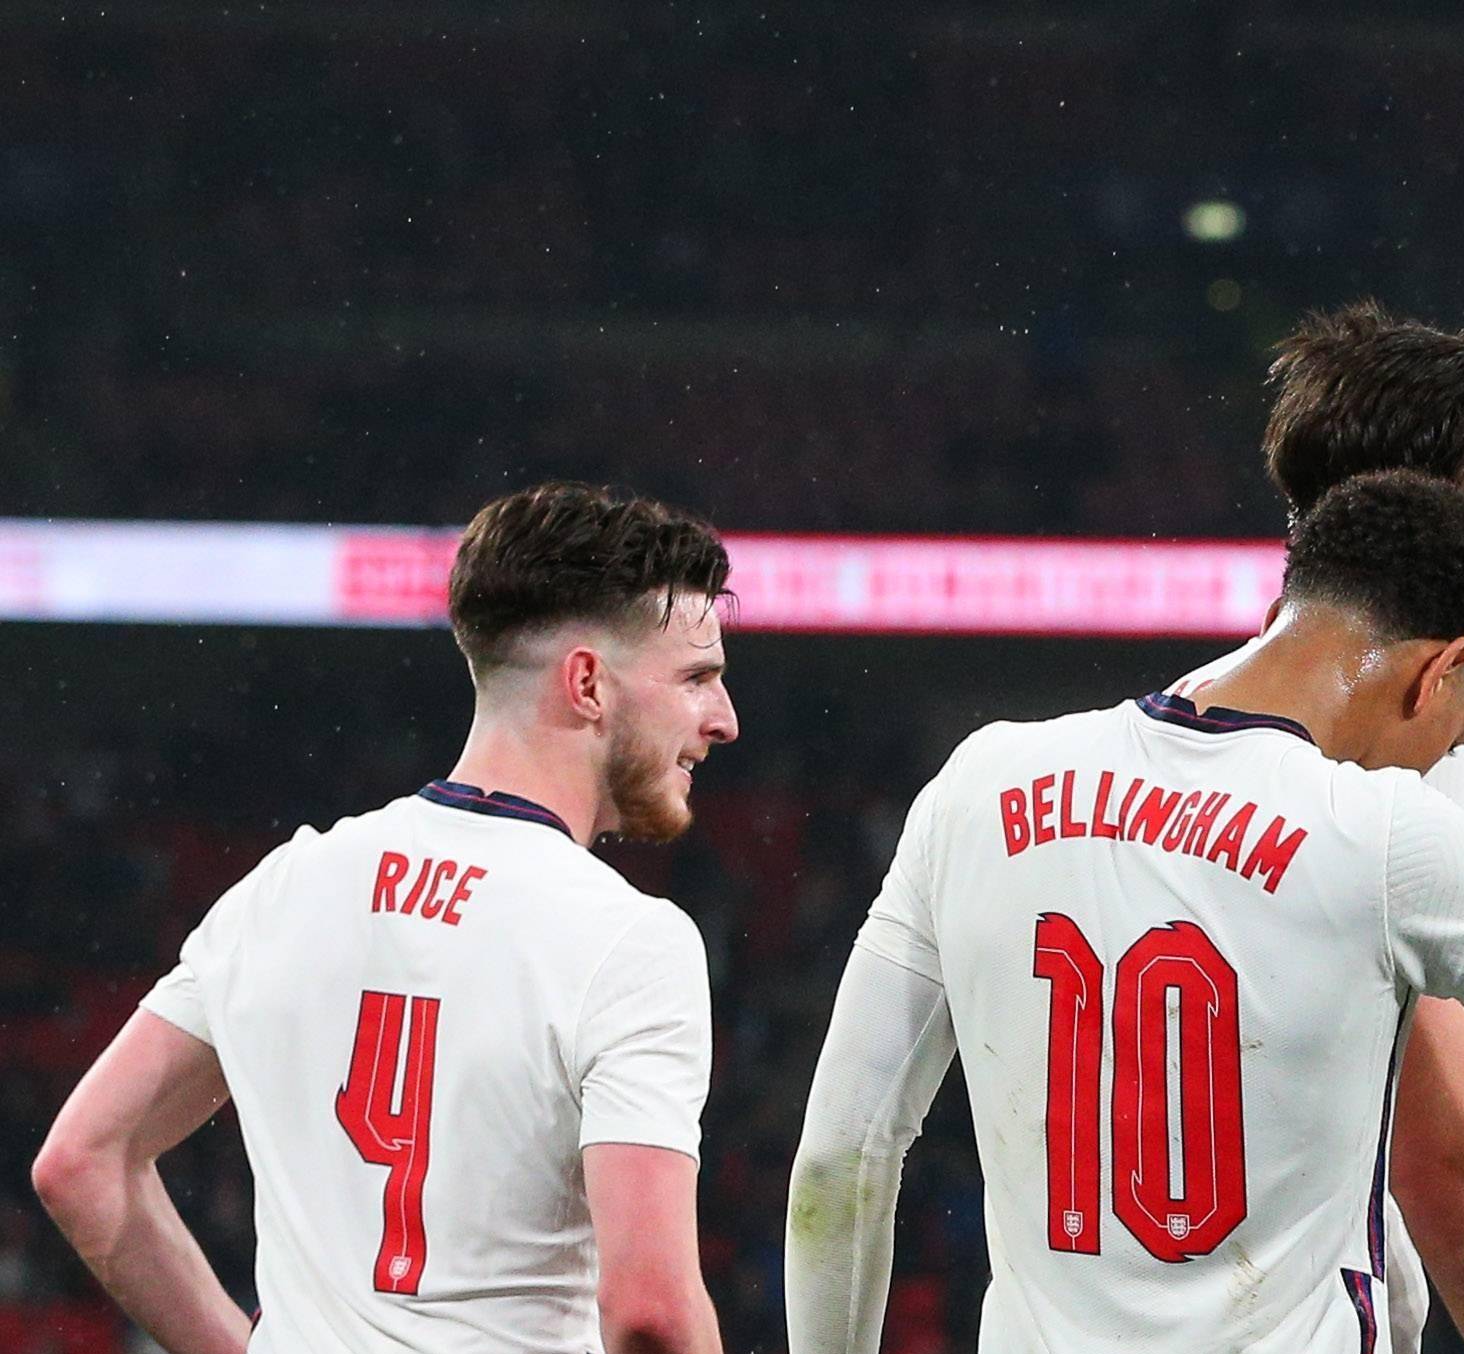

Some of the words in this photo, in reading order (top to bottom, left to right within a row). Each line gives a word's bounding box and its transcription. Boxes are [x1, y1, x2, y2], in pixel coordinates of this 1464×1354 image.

[371, 850, 487, 926] RICE
[999, 769, 1309, 895] BELLINGHAM
[334, 989, 442, 1297] 4
[1032, 911, 1248, 1264] 10
